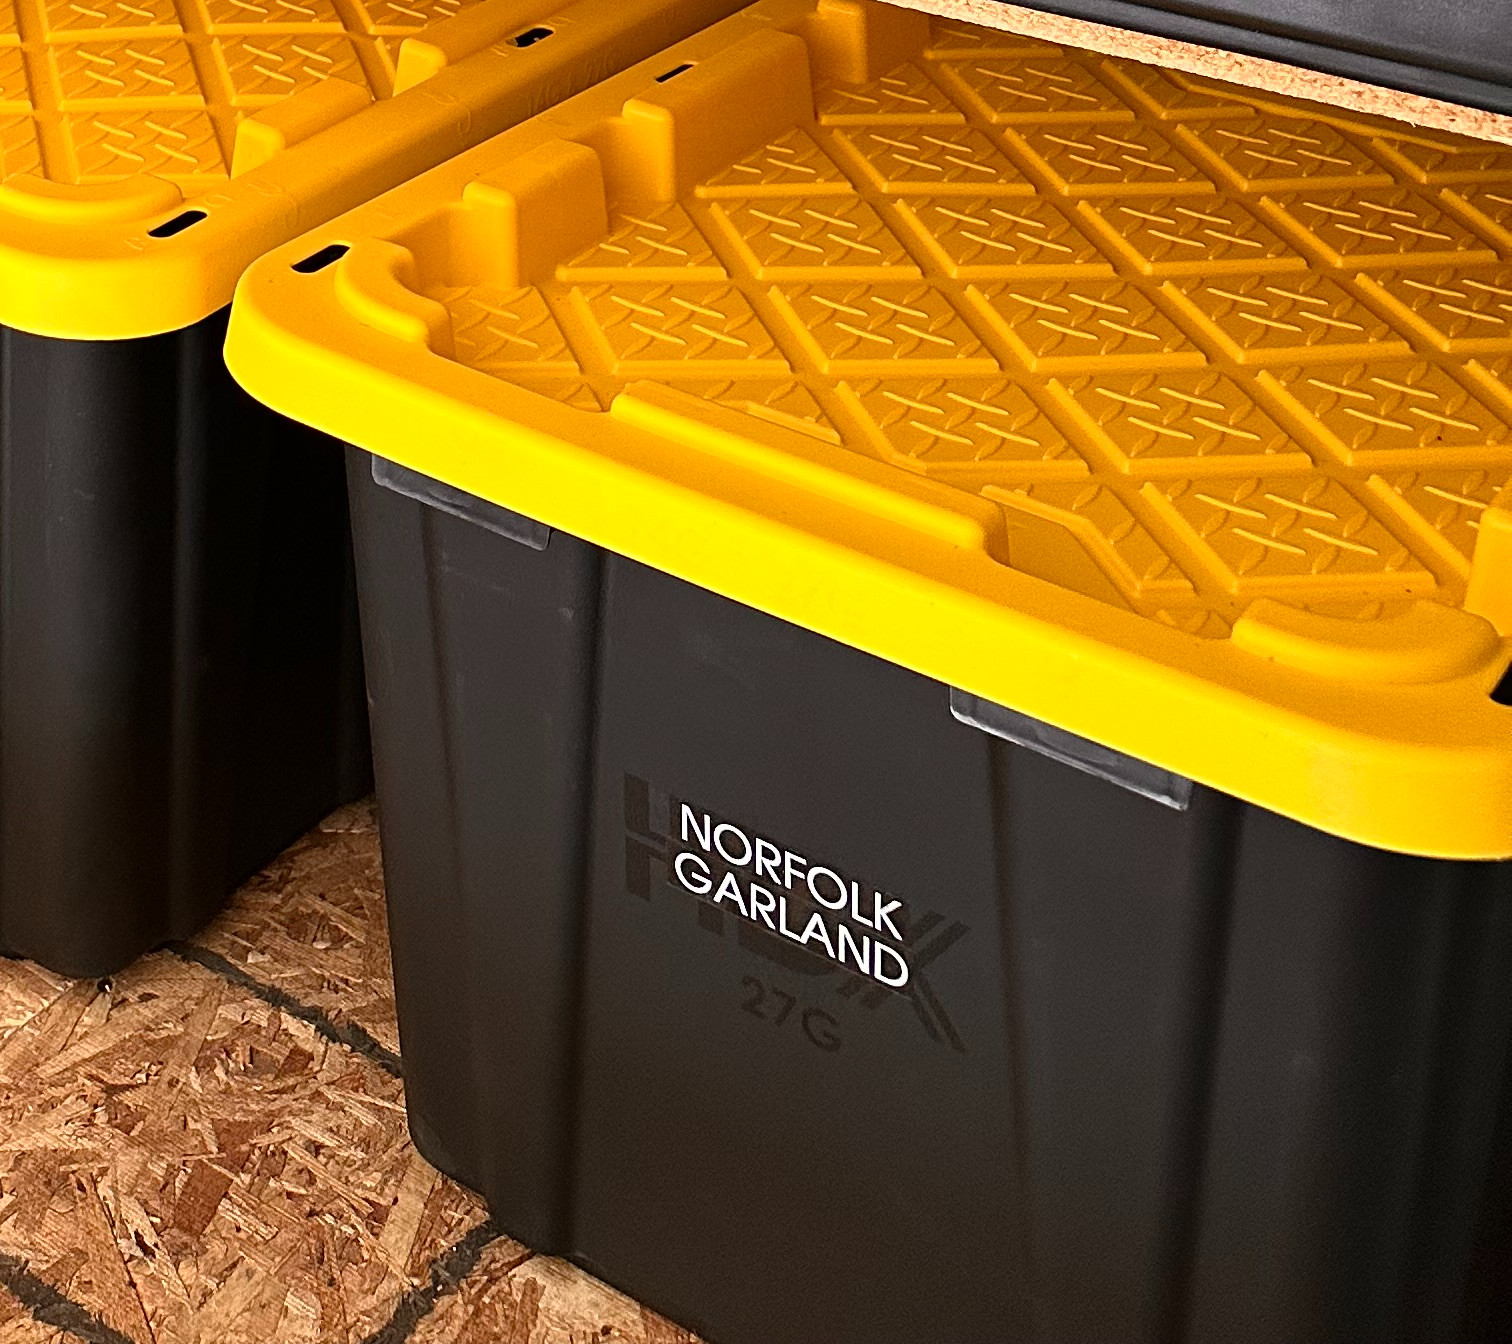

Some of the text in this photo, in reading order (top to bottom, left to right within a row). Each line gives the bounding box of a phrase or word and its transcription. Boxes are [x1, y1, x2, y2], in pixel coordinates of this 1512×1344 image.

[674, 851, 910, 988] GARLAND
[681, 802, 903, 942] NORFOLK
[741, 974, 842, 1053] 27G
